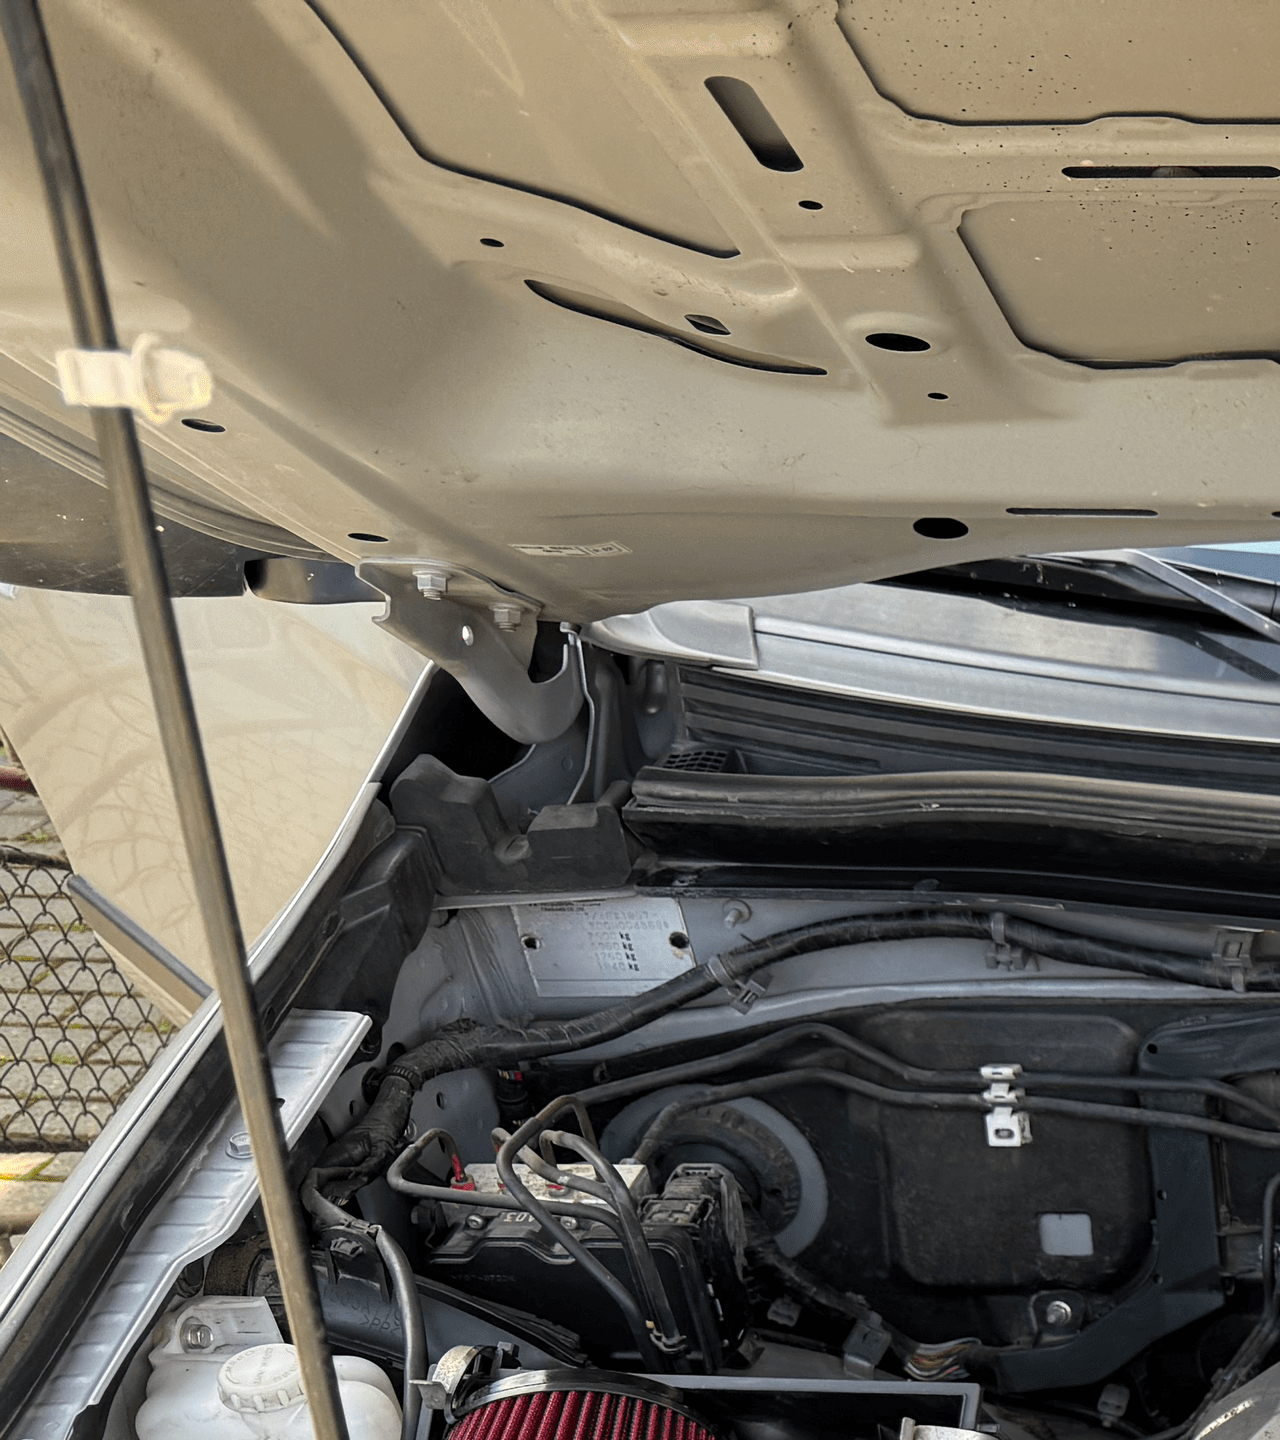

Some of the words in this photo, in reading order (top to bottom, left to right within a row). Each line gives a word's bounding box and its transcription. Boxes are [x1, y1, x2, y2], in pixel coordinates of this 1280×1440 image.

[619, 932, 631, 941] kg
[622, 942, 634, 951] kg
[625, 952, 637, 961] kg
[628, 962, 640, 971] kg
